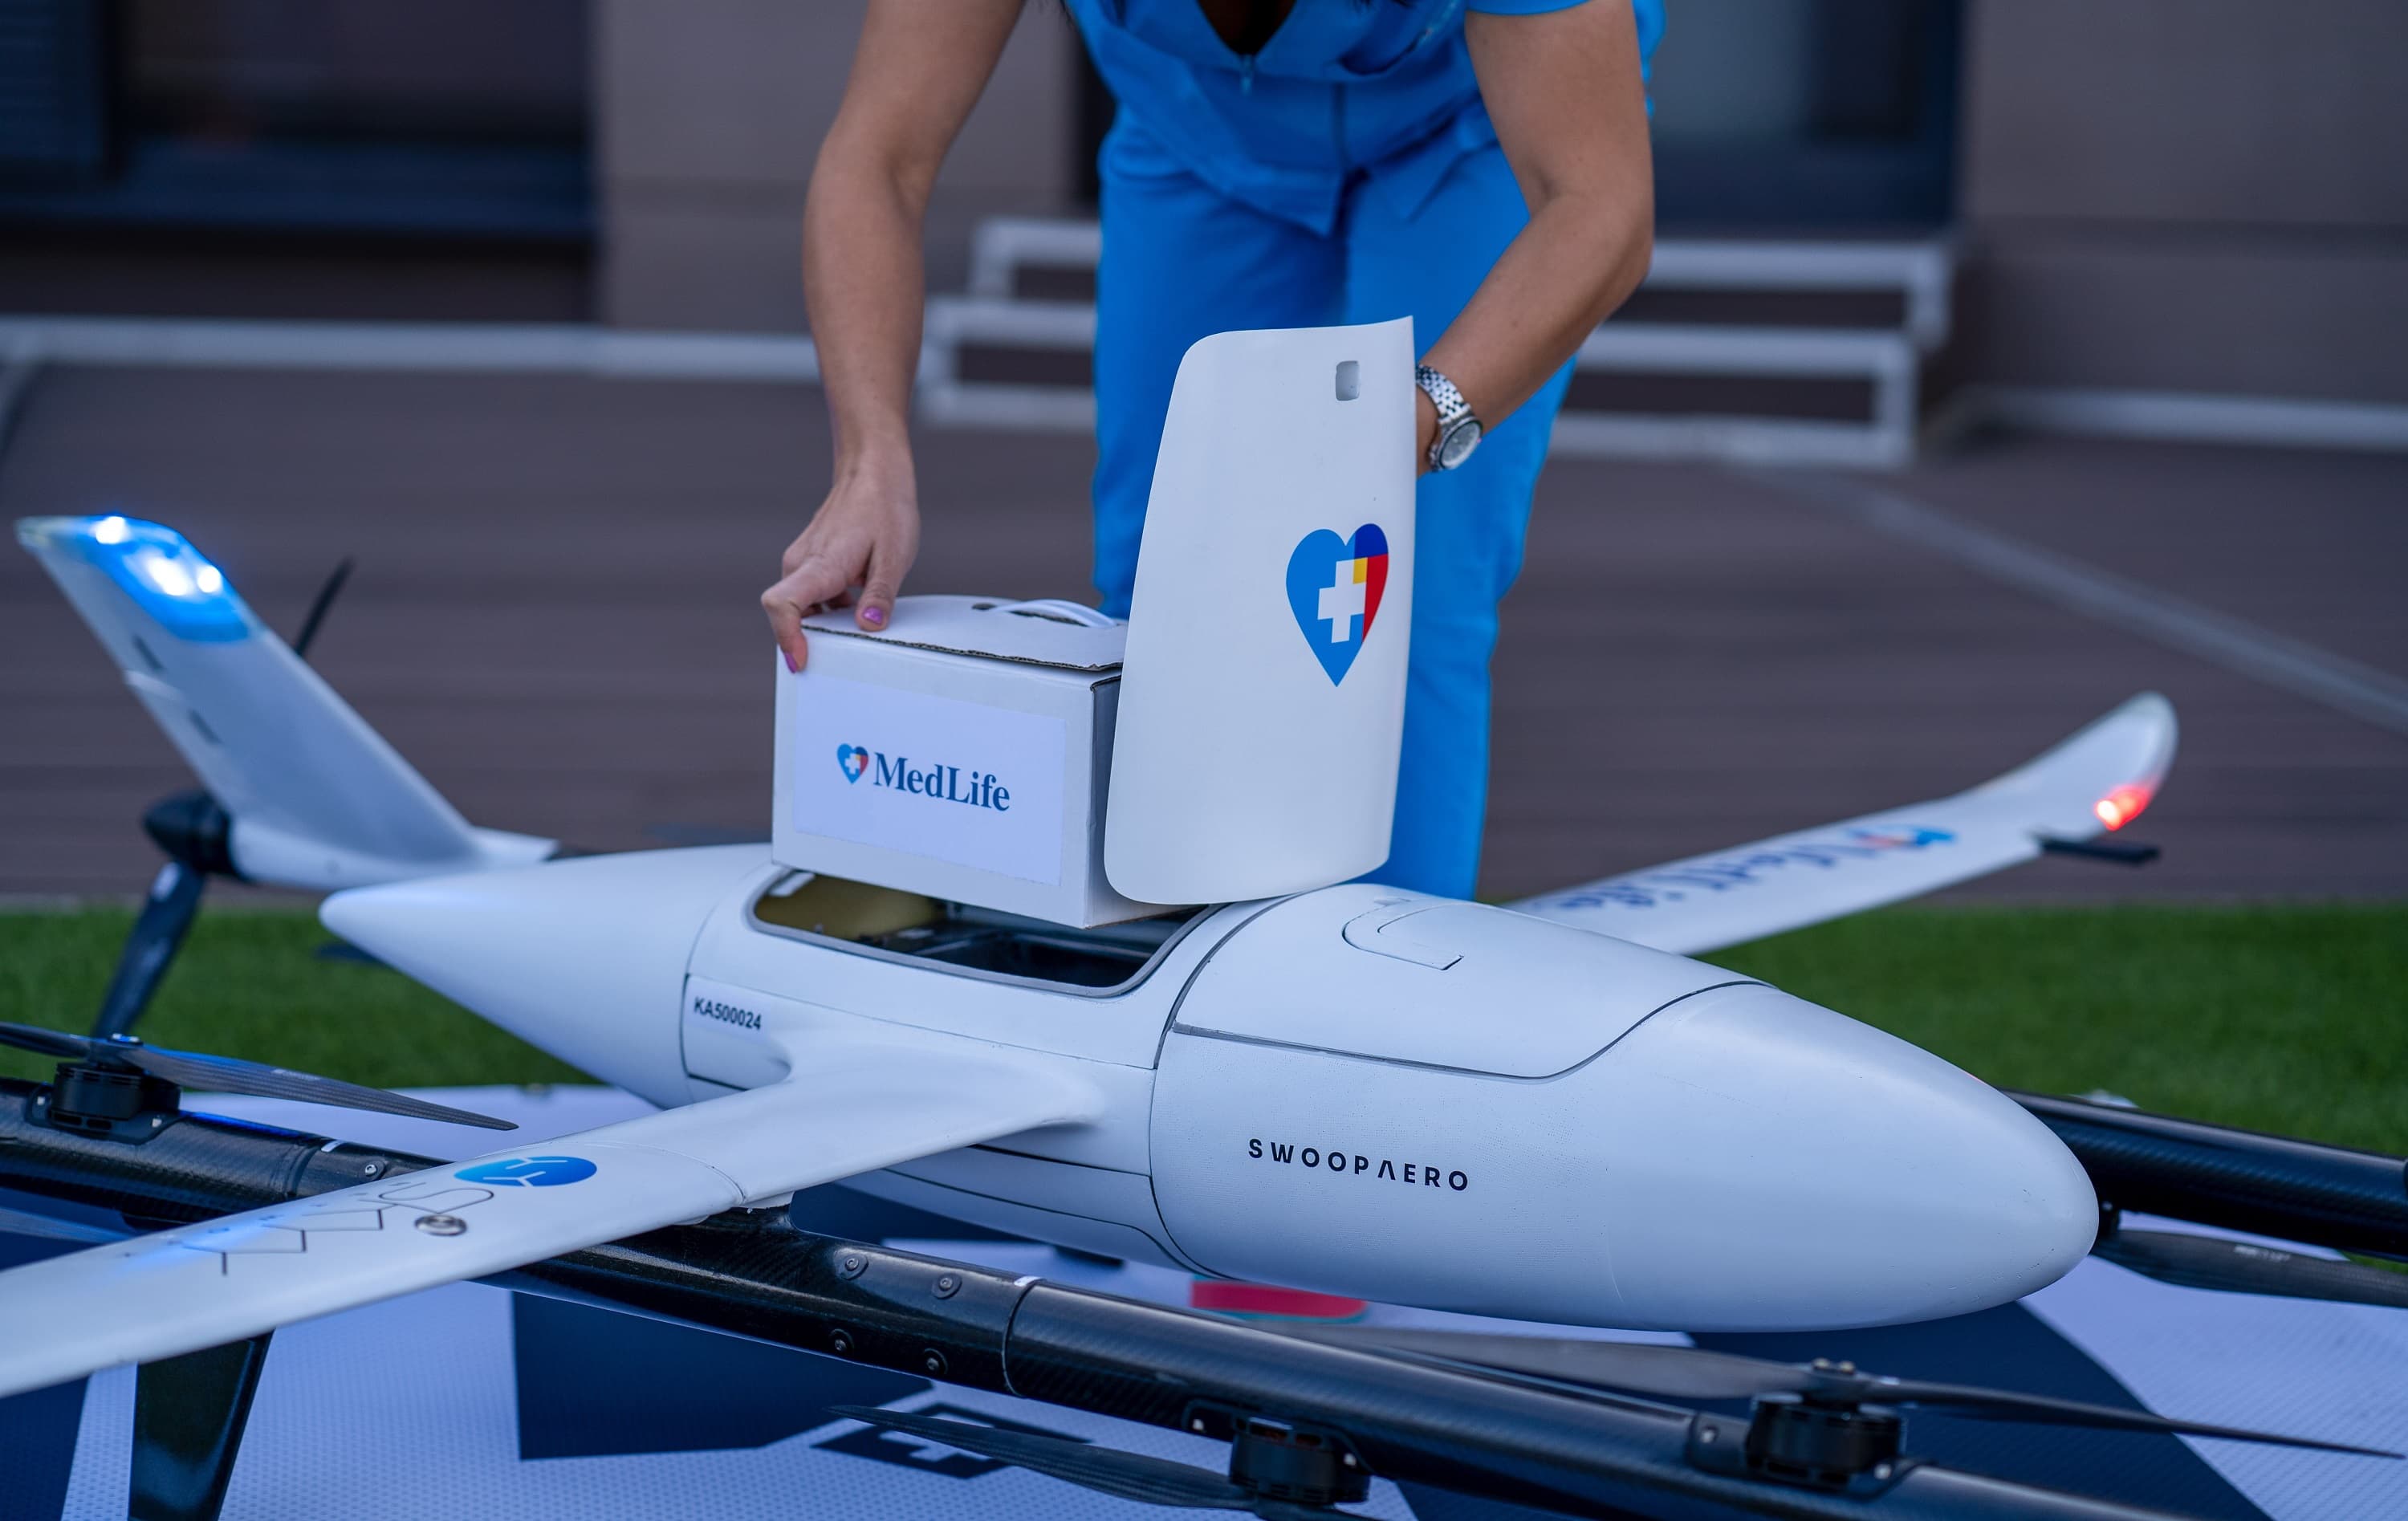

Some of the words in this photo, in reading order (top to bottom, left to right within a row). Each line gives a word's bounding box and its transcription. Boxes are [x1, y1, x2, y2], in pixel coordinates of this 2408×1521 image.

[873, 751, 1011, 811] MedLife
[694, 996, 763, 1031] KA500024
[1247, 1138, 1469, 1192] SWOOPAERO
